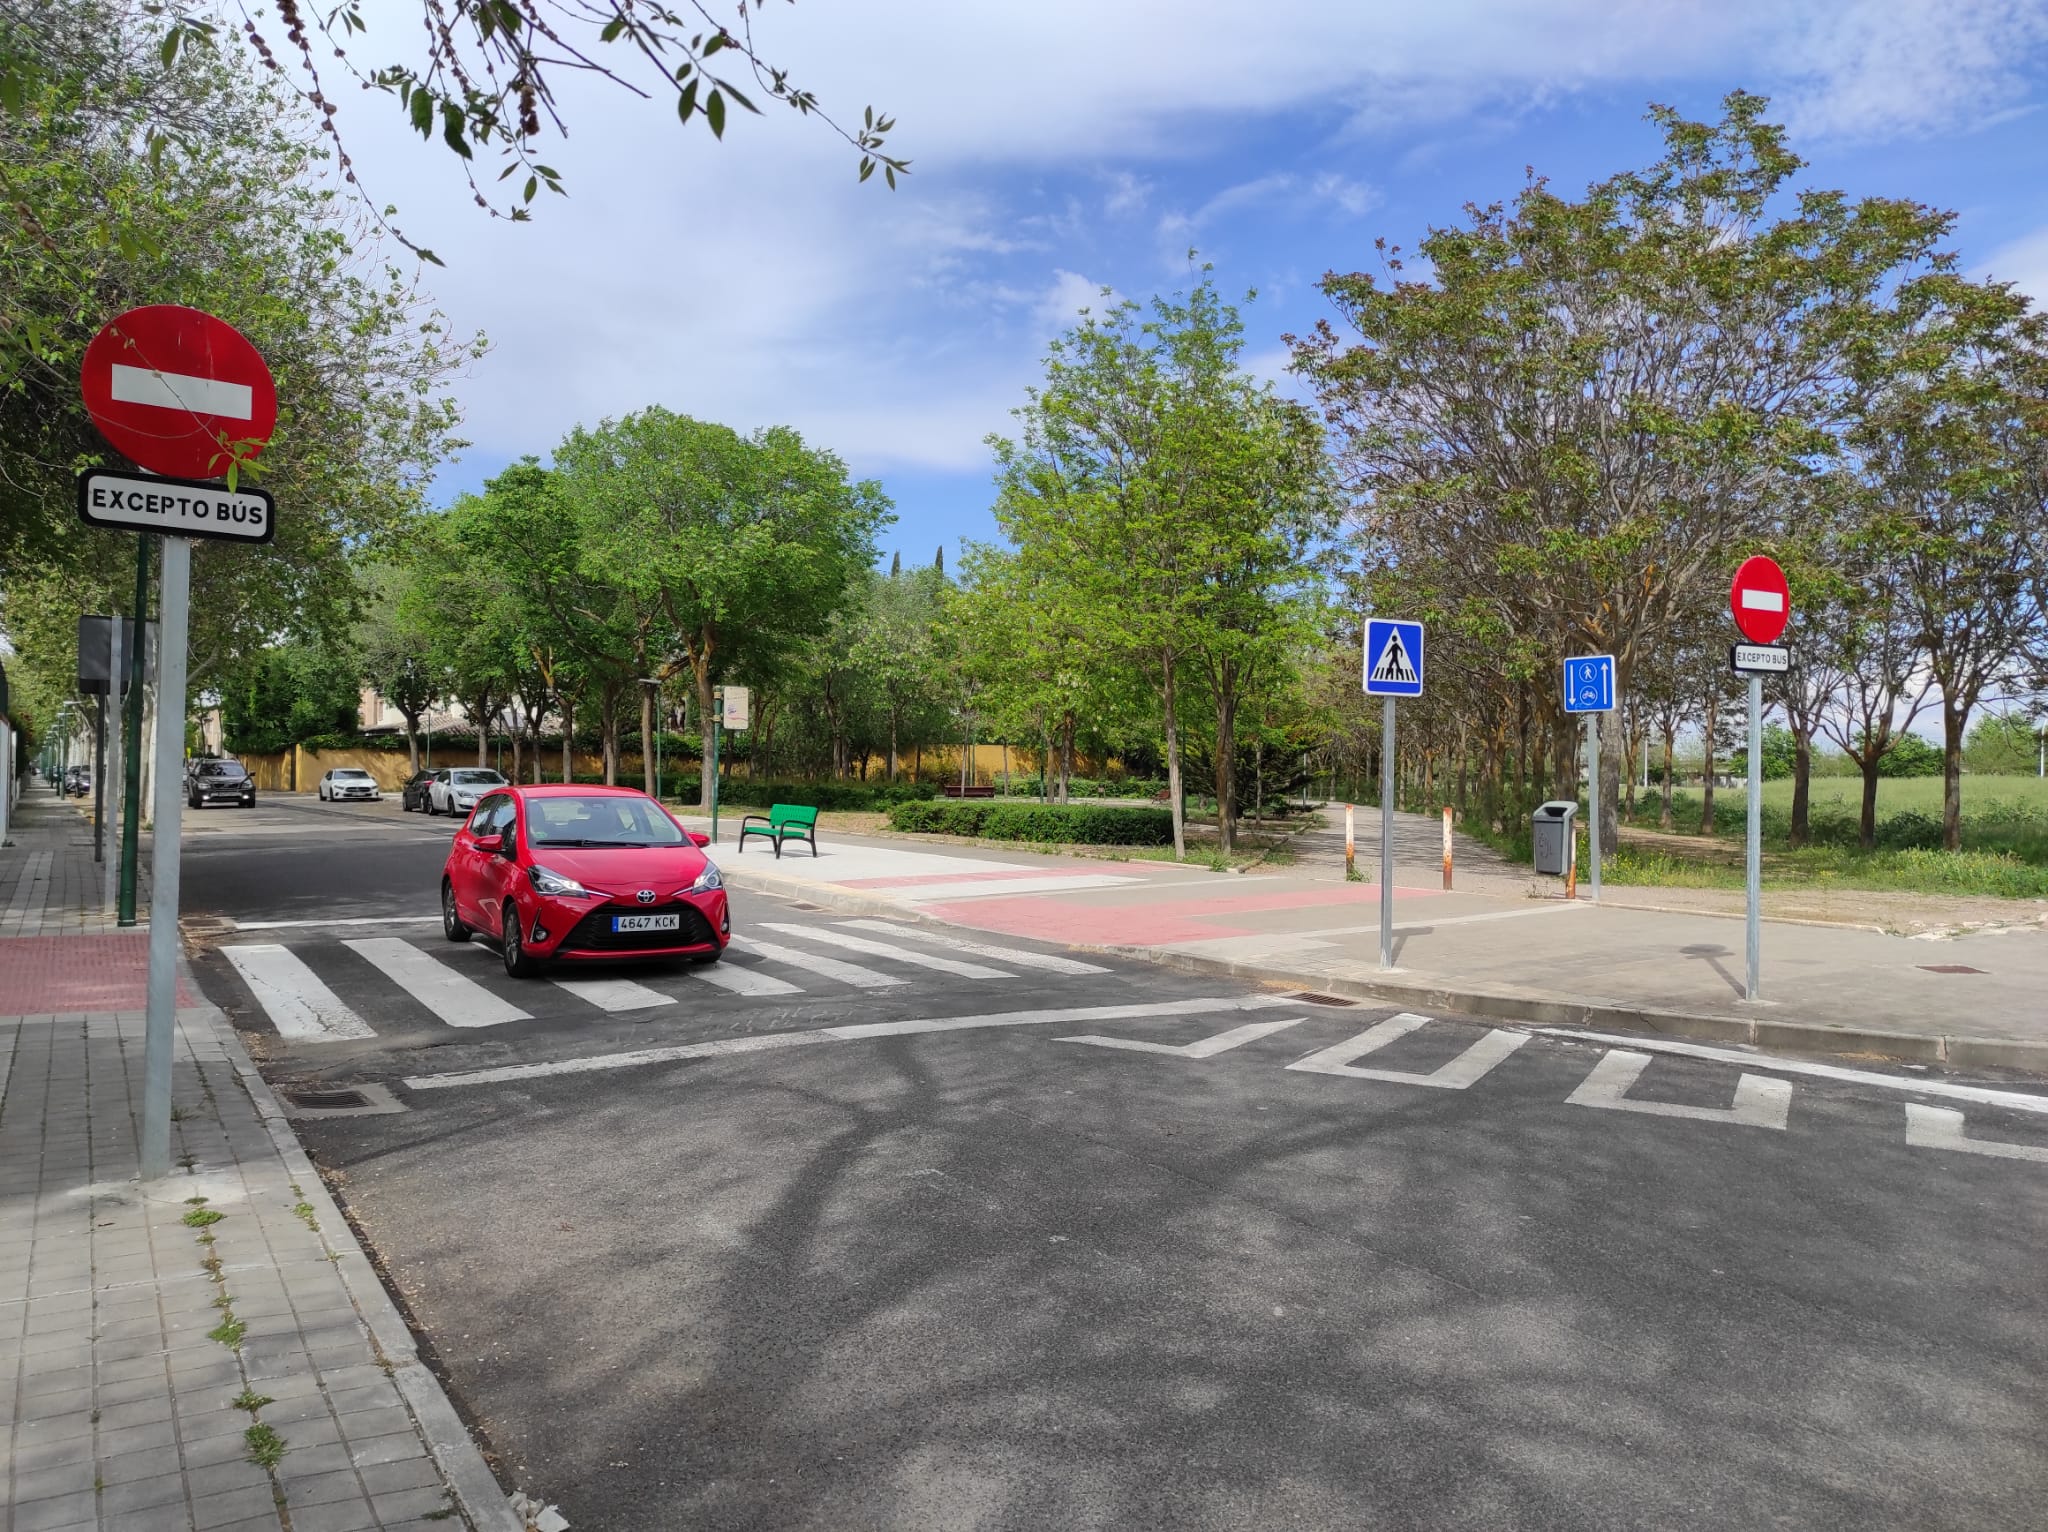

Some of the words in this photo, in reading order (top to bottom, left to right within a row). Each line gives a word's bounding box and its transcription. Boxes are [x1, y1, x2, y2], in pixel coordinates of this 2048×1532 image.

[92, 488, 209, 518] EXCEPTO
[216, 501, 263, 525] BÚS
[1737, 651, 1770, 663] EXCEPTO
[1772, 654, 1787, 665] BUS
[621, 917, 651, 929] 4647
[655, 916, 676, 928] KCK
